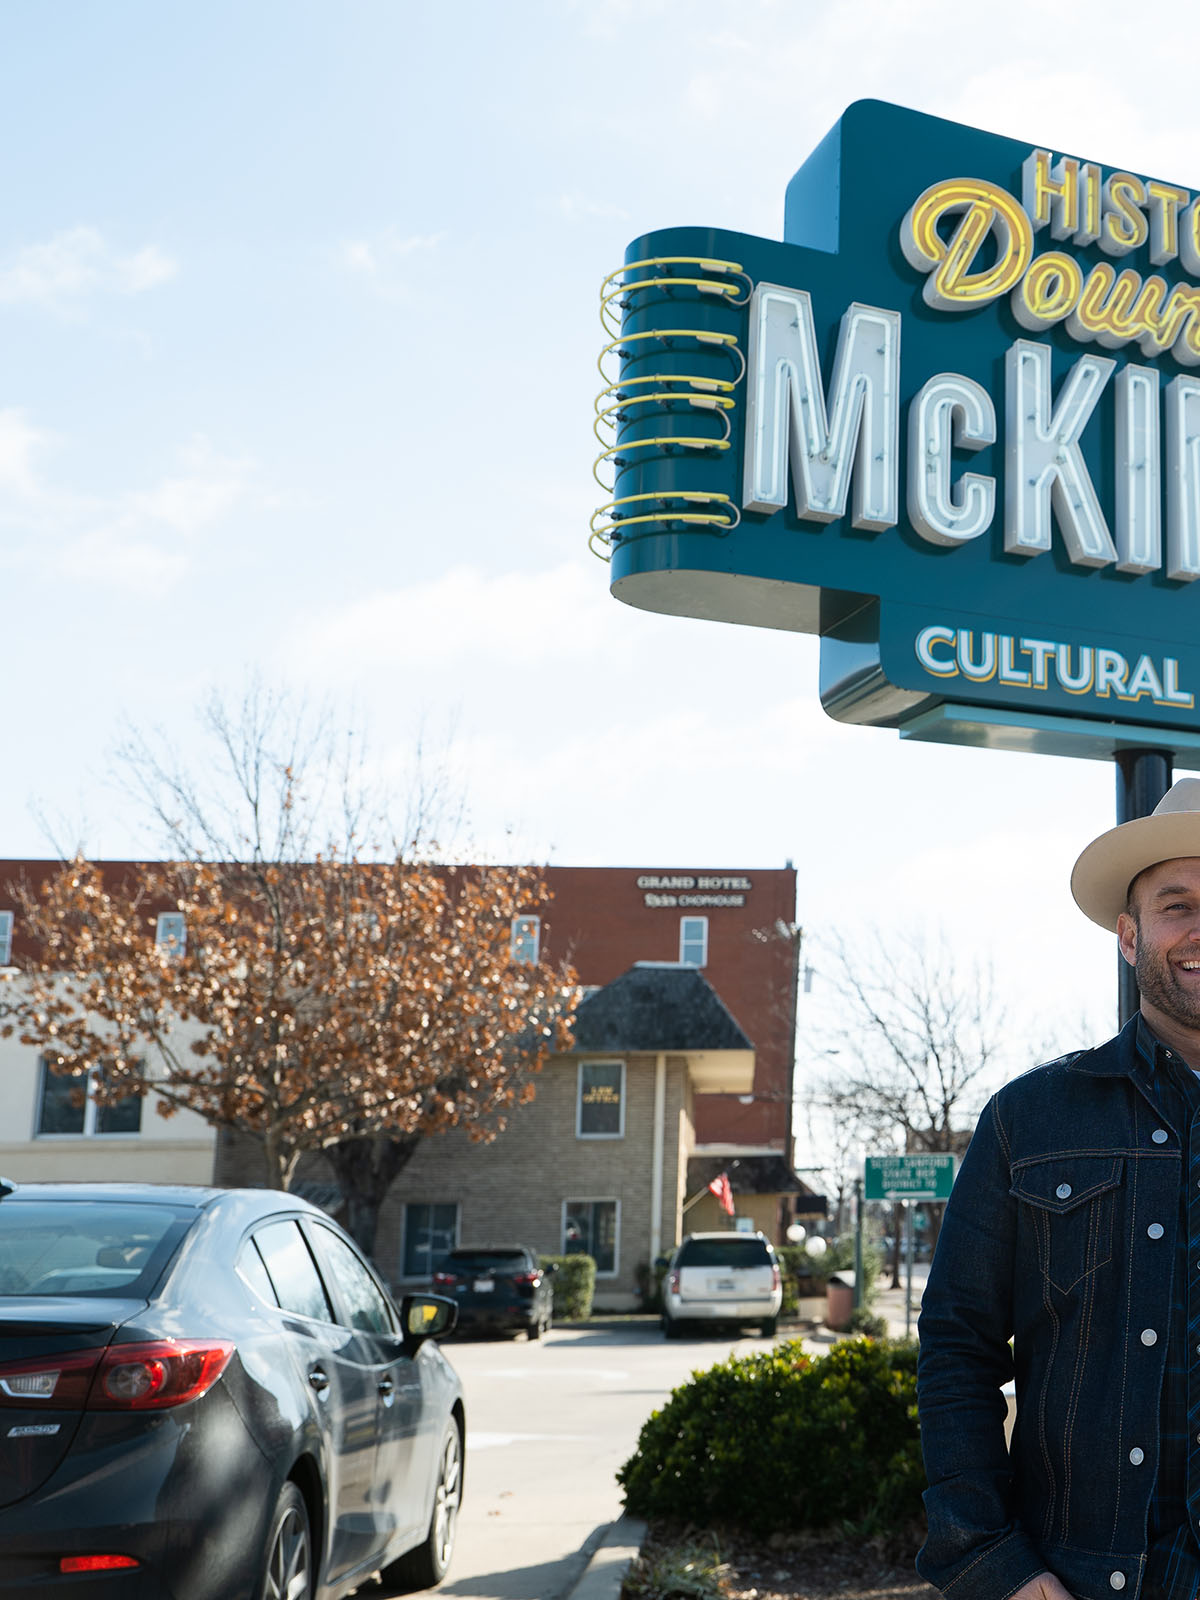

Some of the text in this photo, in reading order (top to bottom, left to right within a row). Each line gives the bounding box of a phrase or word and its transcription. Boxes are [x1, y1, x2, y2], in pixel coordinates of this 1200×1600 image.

[914, 625, 1195, 709] CULTURAL
[636, 875, 752, 890] GRAND HOTEL
